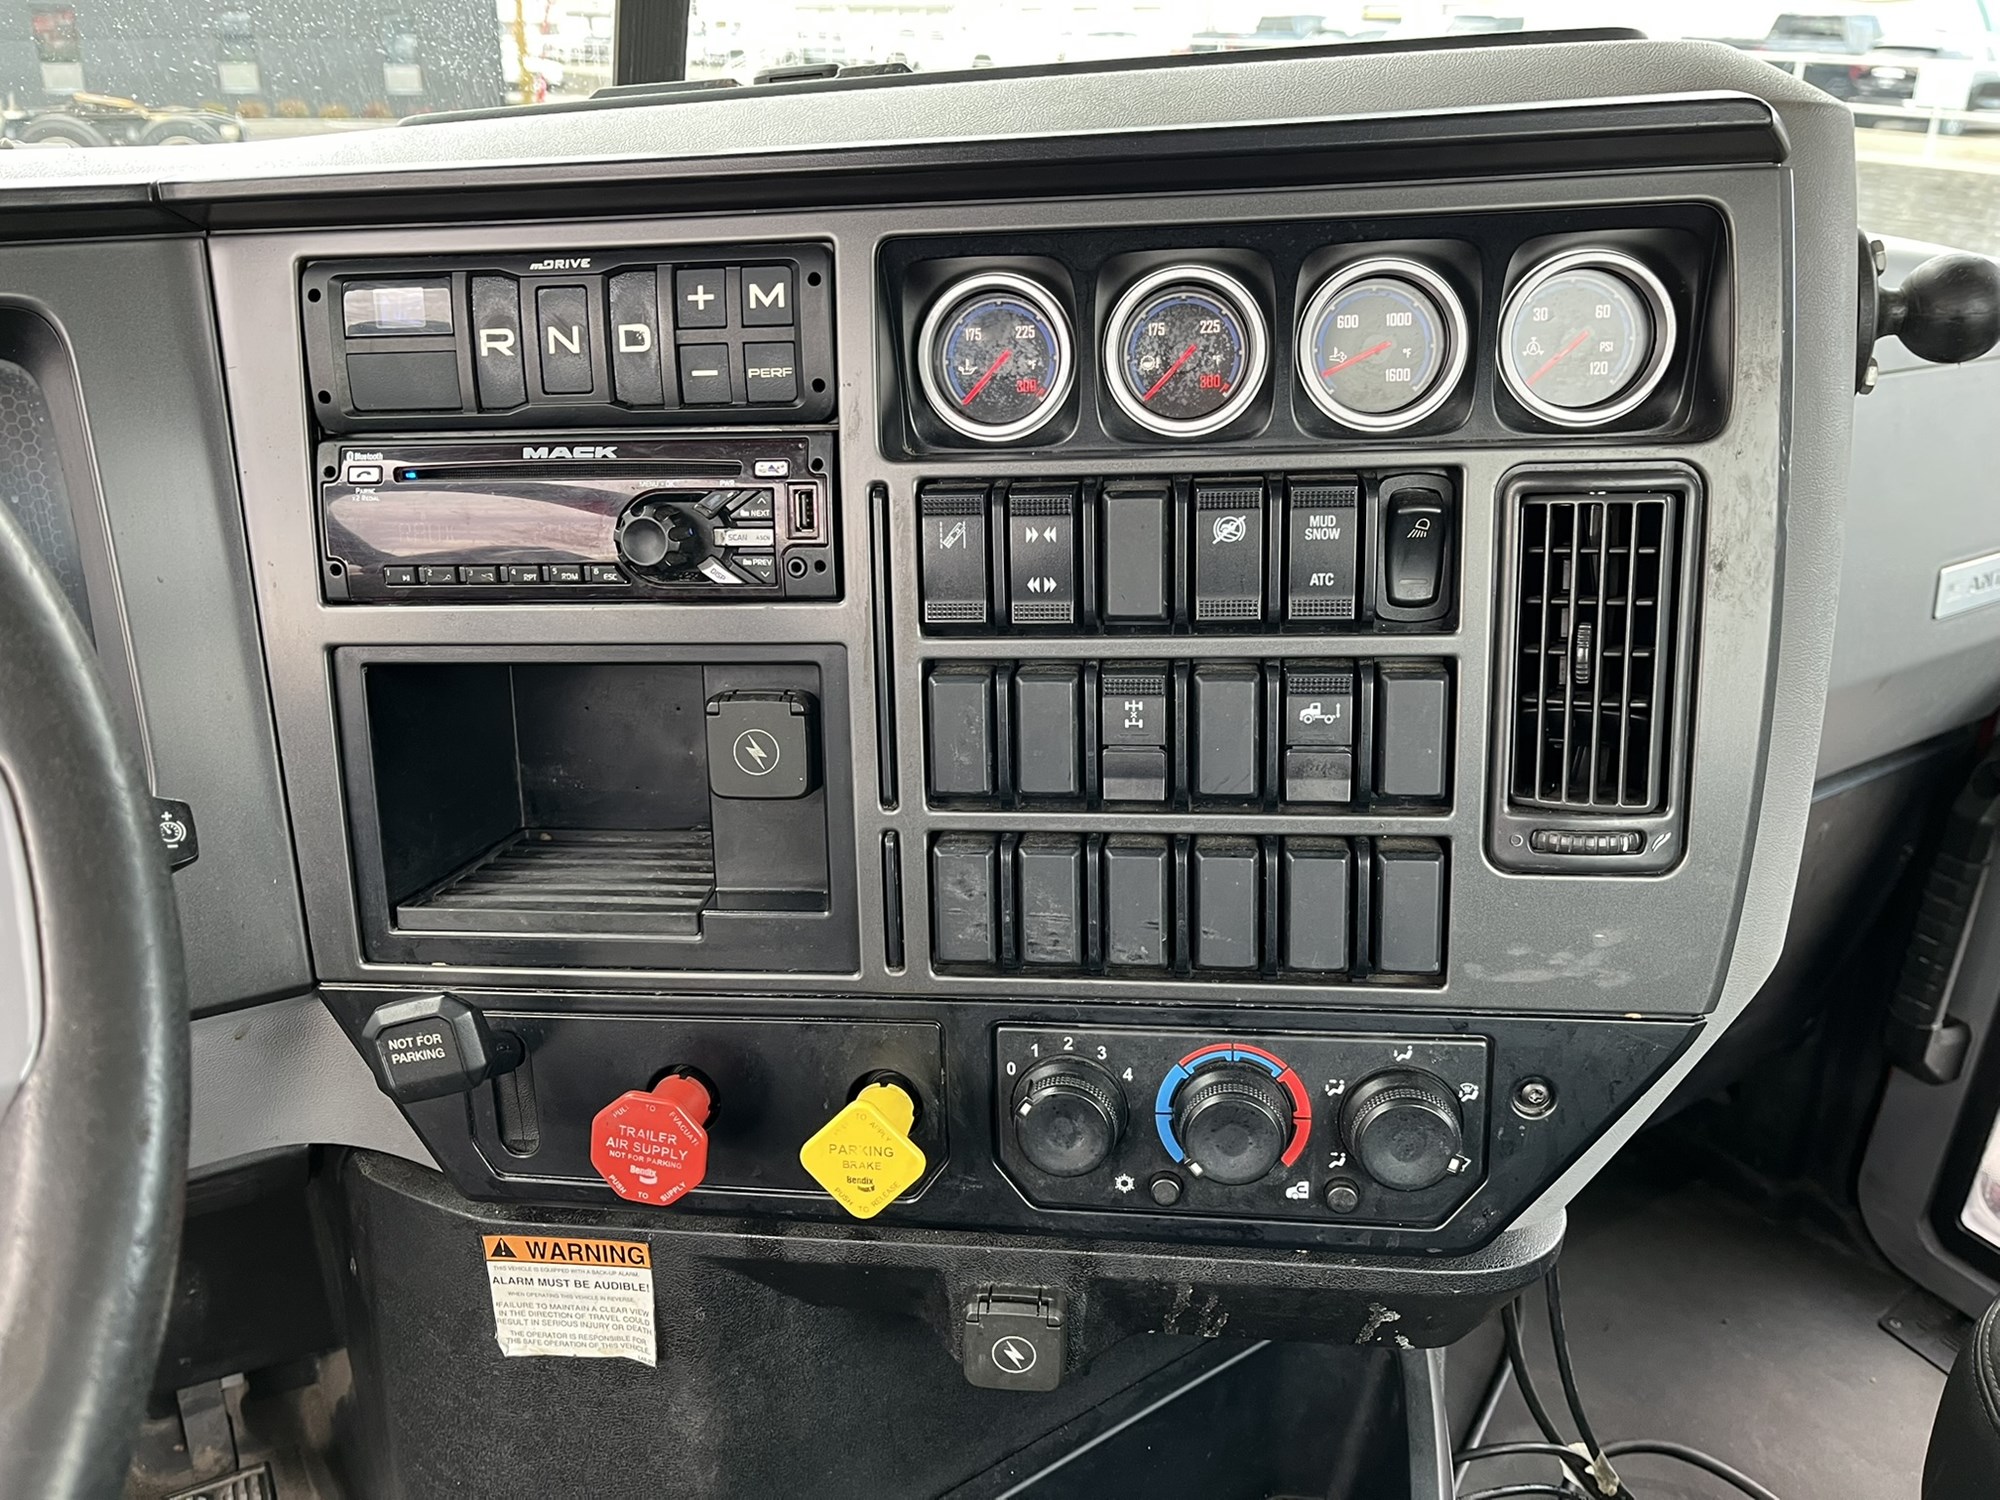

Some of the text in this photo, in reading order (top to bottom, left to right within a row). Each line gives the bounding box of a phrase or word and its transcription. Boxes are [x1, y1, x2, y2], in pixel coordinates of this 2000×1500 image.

[530, 258, 591, 270] mDRIVE
[749, 282, 785, 310] M
[1532, 307, 1548, 322] 30
[1595, 304, 1611, 319] 60
[1200, 320, 1220, 334] 225
[1337, 314, 1359, 329] 600
[1385, 312, 1412, 327] 1000
[965, 327, 982, 341] 175
[1015, 325, 1036, 339] 225
[1148, 322, 1165, 336] 175
[479, 328, 515, 357] R
[547, 325, 581, 355] N
[618, 323, 651, 353] D
[1599, 340, 1613, 353] PSI
[748, 367, 793, 379] PERF
[1385, 367, 1411, 383] 1600
[1589, 361, 1609, 376] 120
[522, 446, 618, 459] MACK
[750, 509, 771, 517] NEXT
[1309, 515, 1336, 528] MUD
[728, 534, 747, 542] SCAN
[1304, 527, 1341, 541] SNOW
[752, 558, 773, 566] PREV
[603, 573, 618, 581] ESC
[1309, 573, 1335, 587] ATC
[388, 1033, 443, 1051] NOT FOR
[1063, 1036, 1074, 1051] 2
[391, 1047, 446, 1065] PARKING
[1030, 1043, 1039, 1058] 1
[1097, 1045, 1107, 1060] 3
[1006, 1061, 1017, 1076] 0
[1122, 1067, 1134, 1082] 4
[619, 1124, 678, 1145] TRAILER
[605, 1136, 689, 1161] AIR SUPPLY
[828, 1143, 894, 1158] PARKING
[609, 1150, 682, 1170] NOT FOR PARKING
[842, 1160, 882, 1171] BRAKE
[629, 1164, 657, 1177] Bendix
[608, 1174, 687, 1202] PUSH TO SUPPLY
[834, 1186, 854, 1206] PUSH
[871, 1181, 901, 1208] RELEASE
[525, 1240, 645, 1265] WARNING
[492, 1276, 650, 1293] ALARM MUST BE AUDIBLE!
[549, 1303, 590, 1312] MAINTAIN
[599, 1305, 628, 1314] CLEAR
[629, 1307, 650, 1317] VIEW
[528, 1310, 573, 1319] DIRECTION
[574, 1312, 587, 1320] OF
[589, 1313, 620, 1322] TRAVEL
[622, 1315, 650, 1327] COULD
[541, 1319, 579, 1328] SERIOUS
[580, 1321, 610, 1330] INJURY
[612, 1323, 625, 1331] OR
[626, 1324, 652, 1336] DEATH
[506, 1337, 521, 1345] THE
[523, 1338, 543, 1346] SAFE
[544, 1339, 587, 1348] OPERATION
[526, 1330, 568, 1339] OPERATOR
[578, 1333, 630, 1342] RESPONSIBLE
[632, 1336, 647, 1345] FOR
